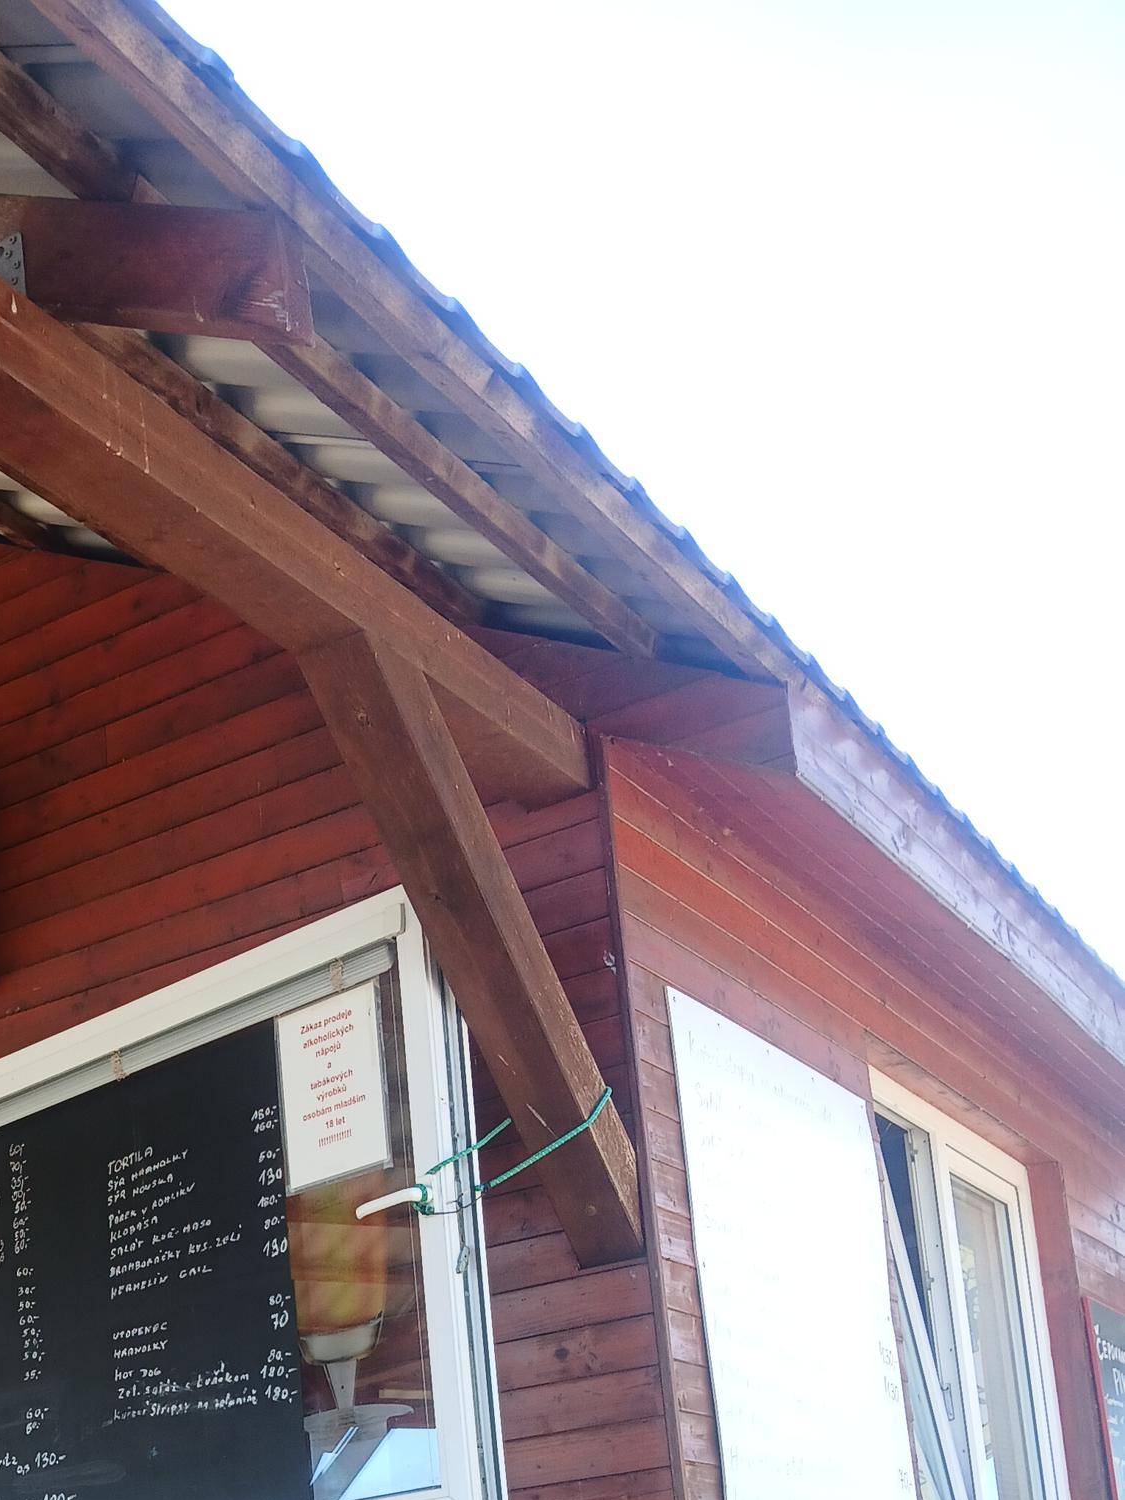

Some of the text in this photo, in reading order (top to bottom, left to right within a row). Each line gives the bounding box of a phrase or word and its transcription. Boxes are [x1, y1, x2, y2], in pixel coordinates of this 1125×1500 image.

[300, 1008, 353, 1035] Zákaz prodeje
[303, 1023, 354, 1049] alkoholických
[315, 1043, 341, 1058] nápojů
[310, 1069, 353, 1090] tabákových
[316, 1084, 347, 1102] výrobků
[302, 1093, 366, 1122] osobám mladším
[325, 1116, 345, 1129] 18 let
[107, 1146, 153, 1175] TORTILA
[131, 1149, 188, 1181] HRANOLKY
[132, 1173, 174, 1197] HOUSKA
[151, 1181, 196, 1209] ROHLÍKU
[109, 1215, 159, 1243] KLOBÁSA
[109, 1238, 145, 1260] SALÁT
[182, 1219, 212, 1234] MASO
[112, 1321, 168, 1340] UTOPENEC
[113, 1309, 289, 1359] HRANOLKY 70
[114, 1366, 134, 1382] HOT
[139, 1367, 162, 1378] DOG
